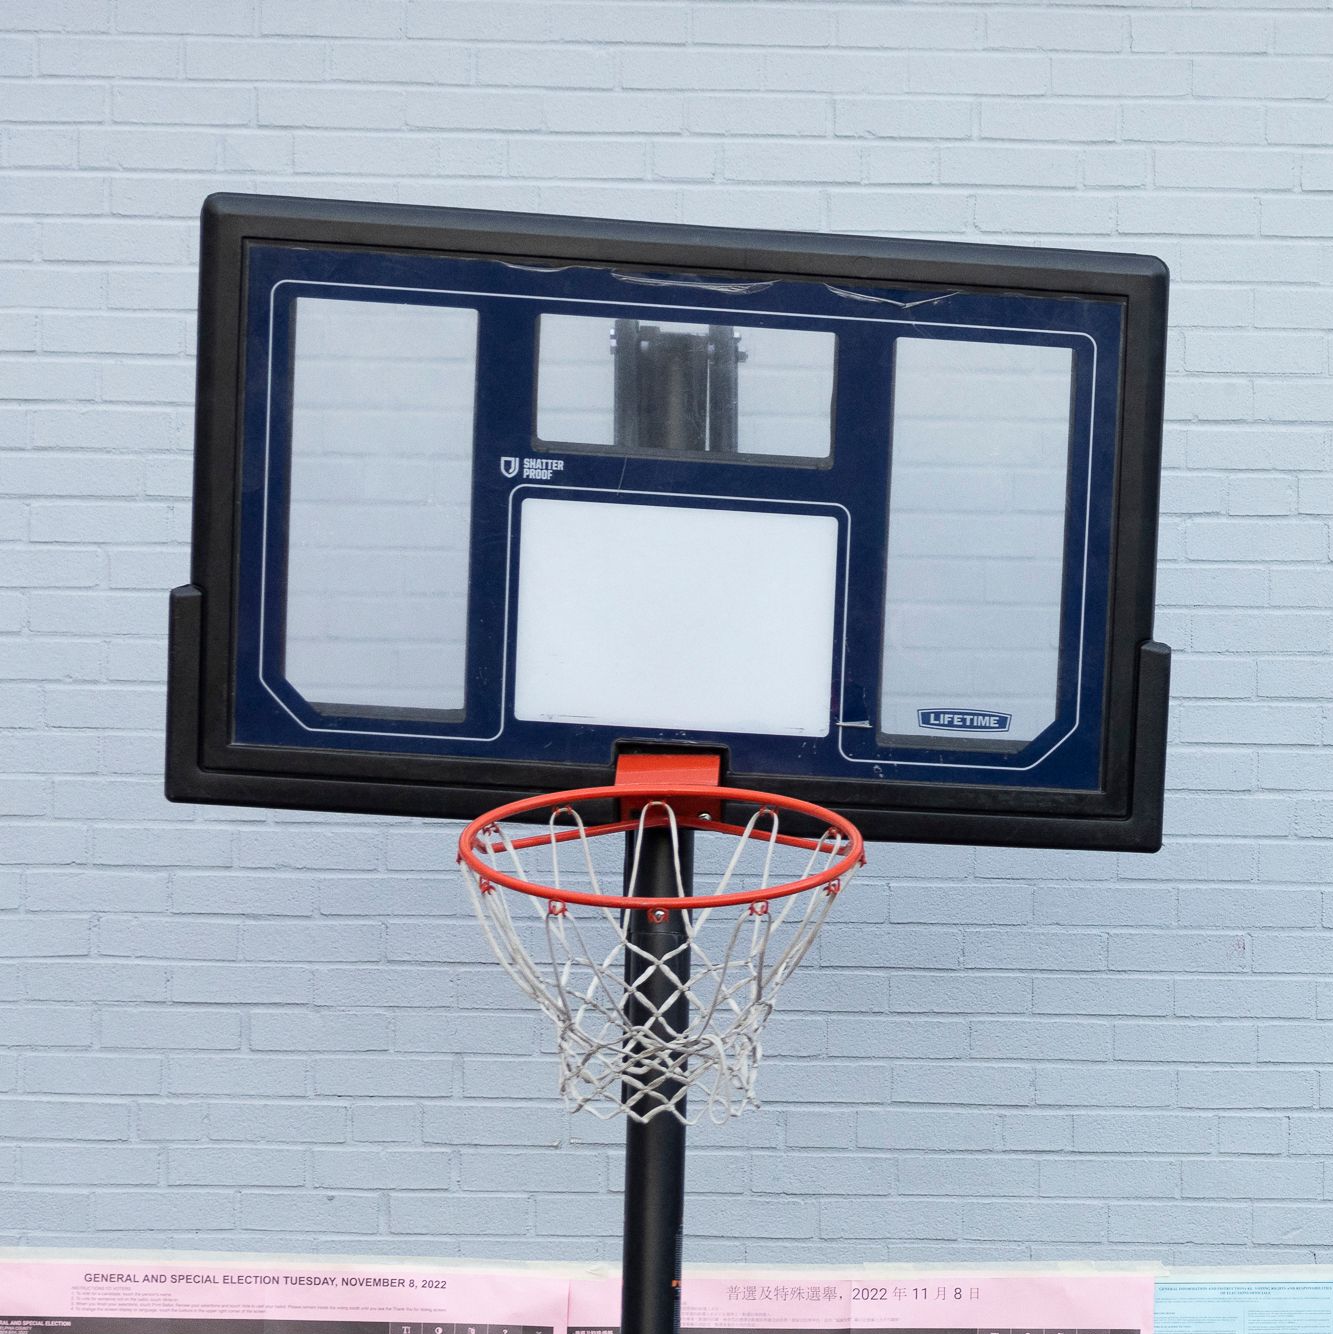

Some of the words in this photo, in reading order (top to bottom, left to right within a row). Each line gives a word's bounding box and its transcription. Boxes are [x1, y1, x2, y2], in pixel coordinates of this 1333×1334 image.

[523, 458, 564, 470] SHATTER
[523, 469, 553, 480] PROOF
[930, 714, 999, 727] LIFETIME
[84, 1273, 140, 1284] GENERAL
[143, 1274, 167, 1284] AND
[170, 1275, 219, 1285] SPECIAL
[223, 1275, 279, 1285] ELECTION
[283, 1276, 338, 1288] TUESDAY,
[341, 1277, 406, 1287] NOVEMBER
[409, 1279, 418, 1290] 8,
[421, 1279, 447, 1289] 2022
[852, 1288, 887, 1300] 2022
[892, 1287, 908, 1301] 年
[913, 1288, 928, 1300] 11
[935, 1287, 947, 1300] 月
[954, 1288, 962, 1300] 8
[970, 1288, 979, 1300] 日
